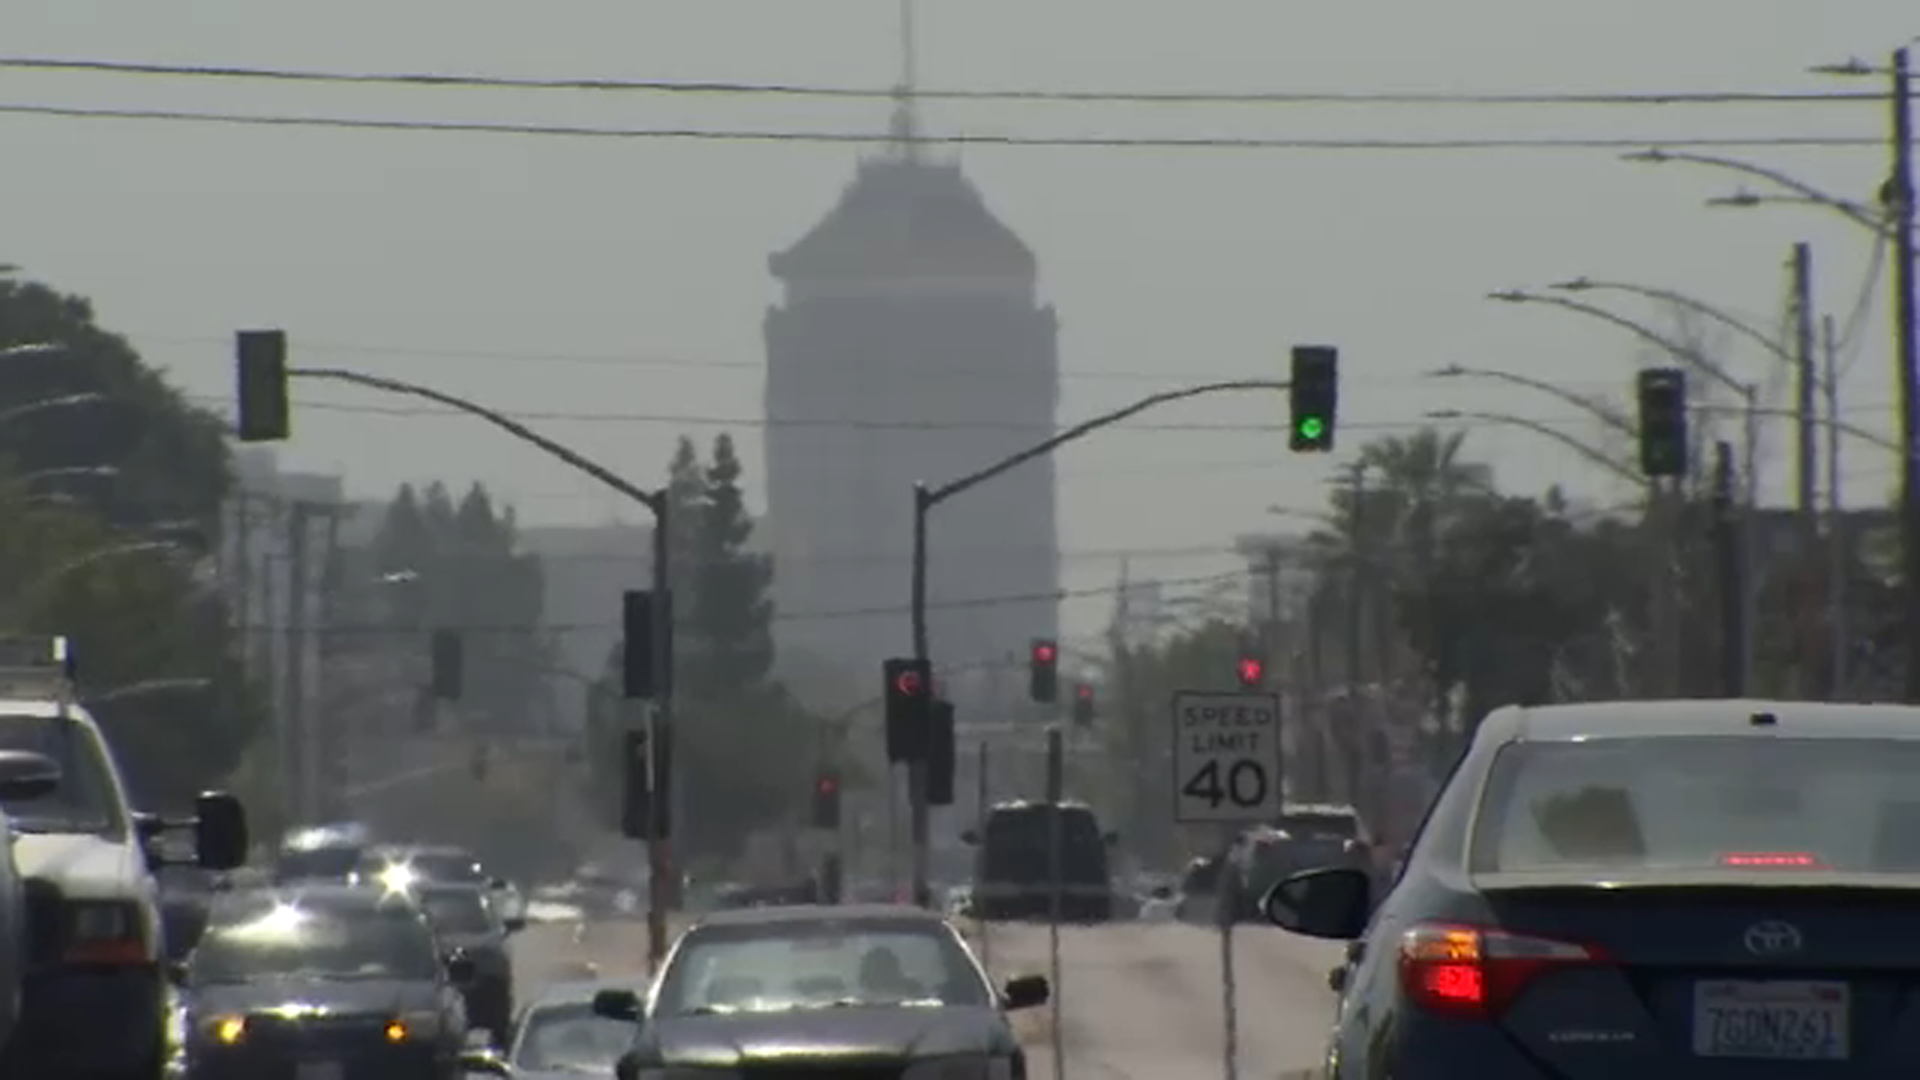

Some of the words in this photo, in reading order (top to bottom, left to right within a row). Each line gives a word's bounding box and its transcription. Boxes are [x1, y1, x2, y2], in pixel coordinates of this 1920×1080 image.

[1184, 706, 1272, 728] SPEED
[1192, 732, 1259, 754] LIMIT
[1183, 759, 1267, 808] 40
